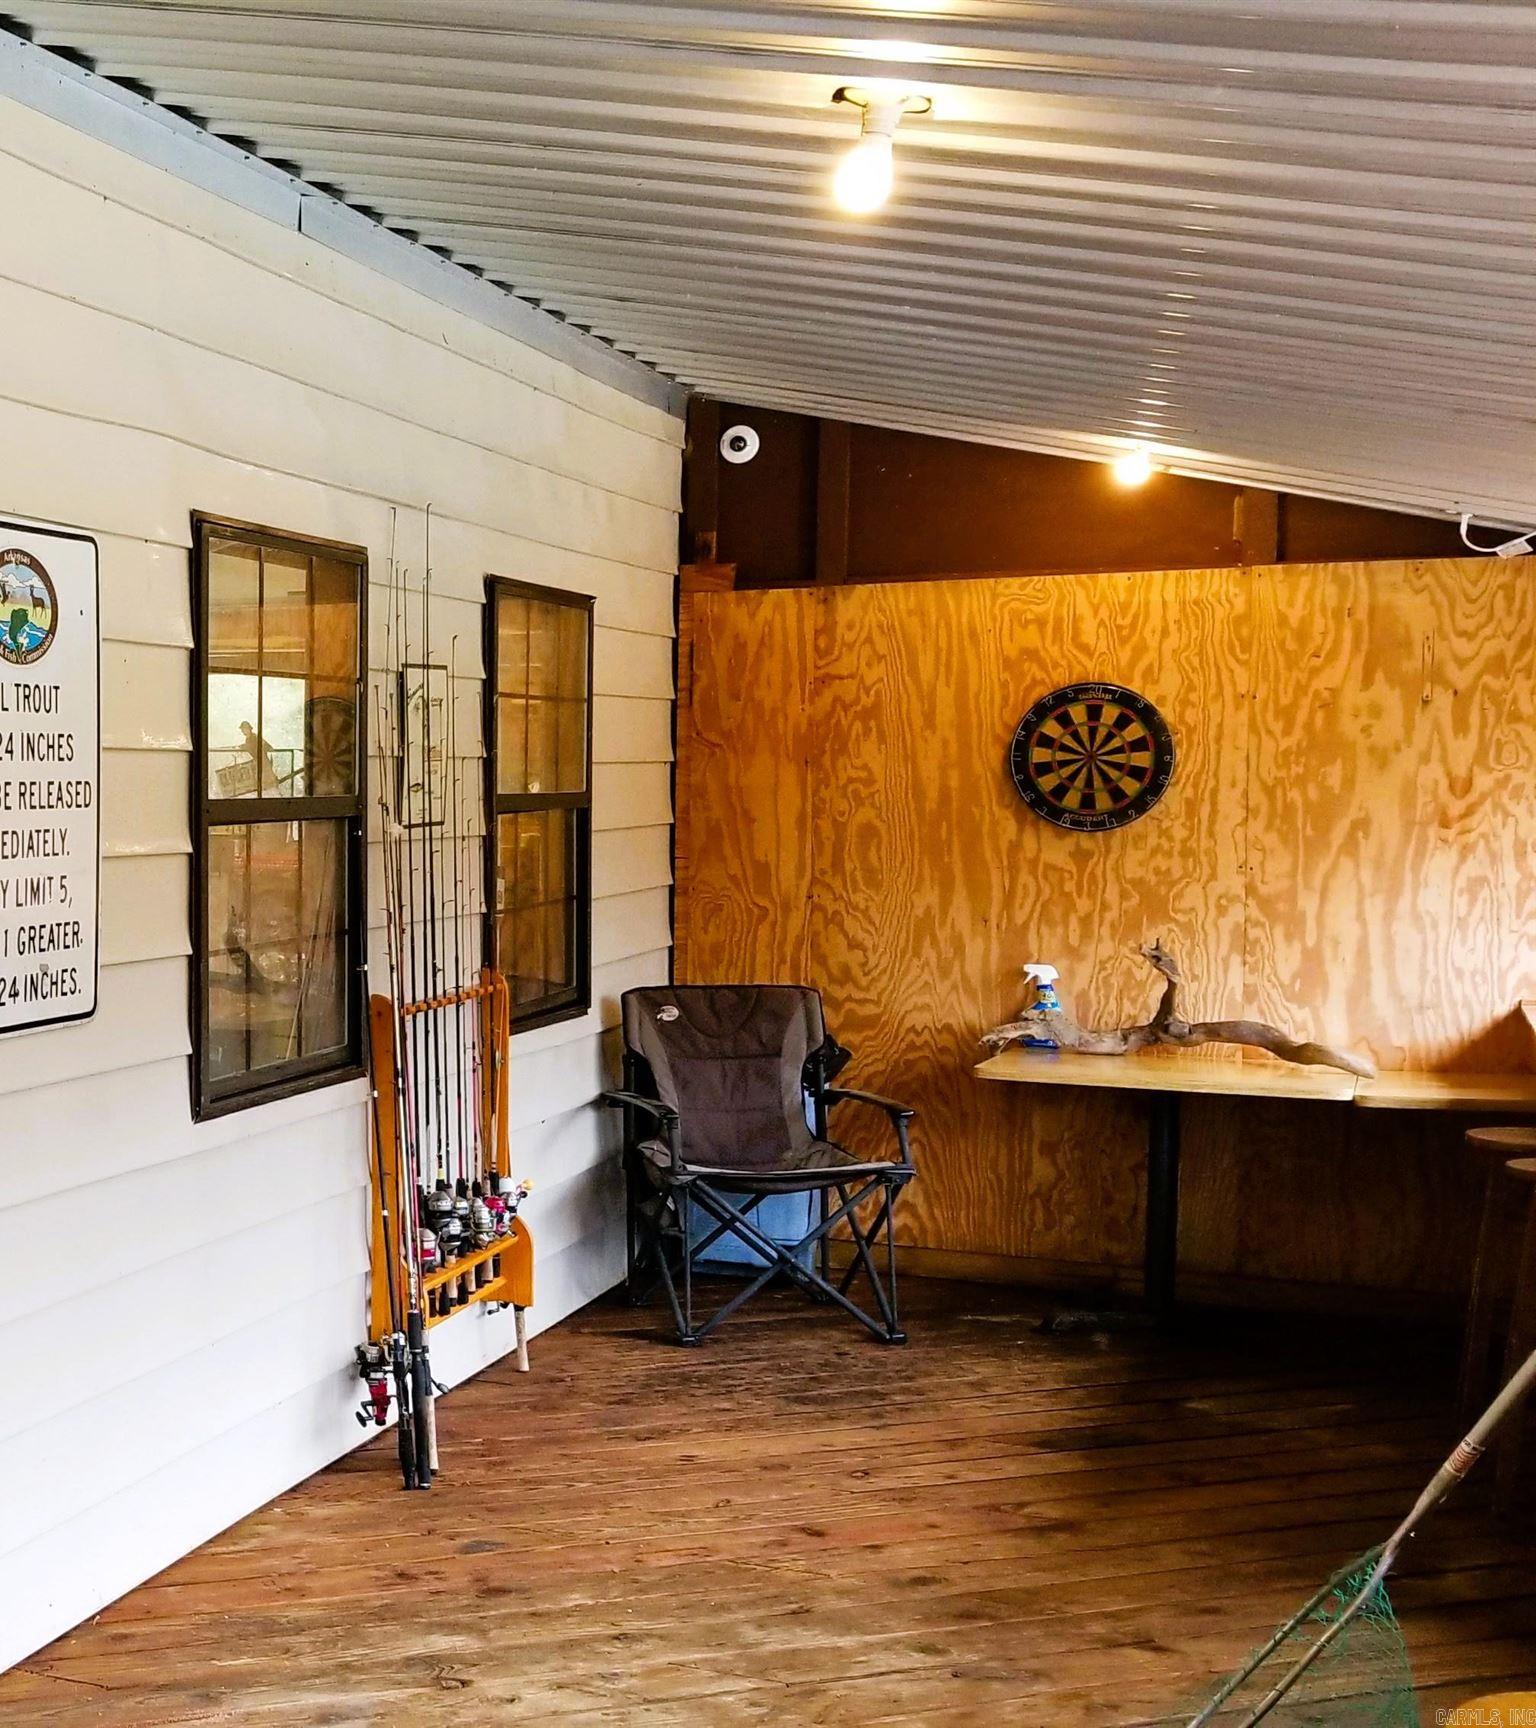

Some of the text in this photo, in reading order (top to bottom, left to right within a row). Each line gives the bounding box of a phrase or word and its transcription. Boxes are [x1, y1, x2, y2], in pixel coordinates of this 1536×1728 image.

[14, 683, 60, 714] TROUT
[21, 732, 74, 762] INCHES
[18, 780, 92, 810] RELEASED
[15, 876, 54, 907] LIMIT
[59, 875, 72, 908] 5,
[4, 929, 9, 958] 1
[24, 967, 81, 1003] INCHES.
